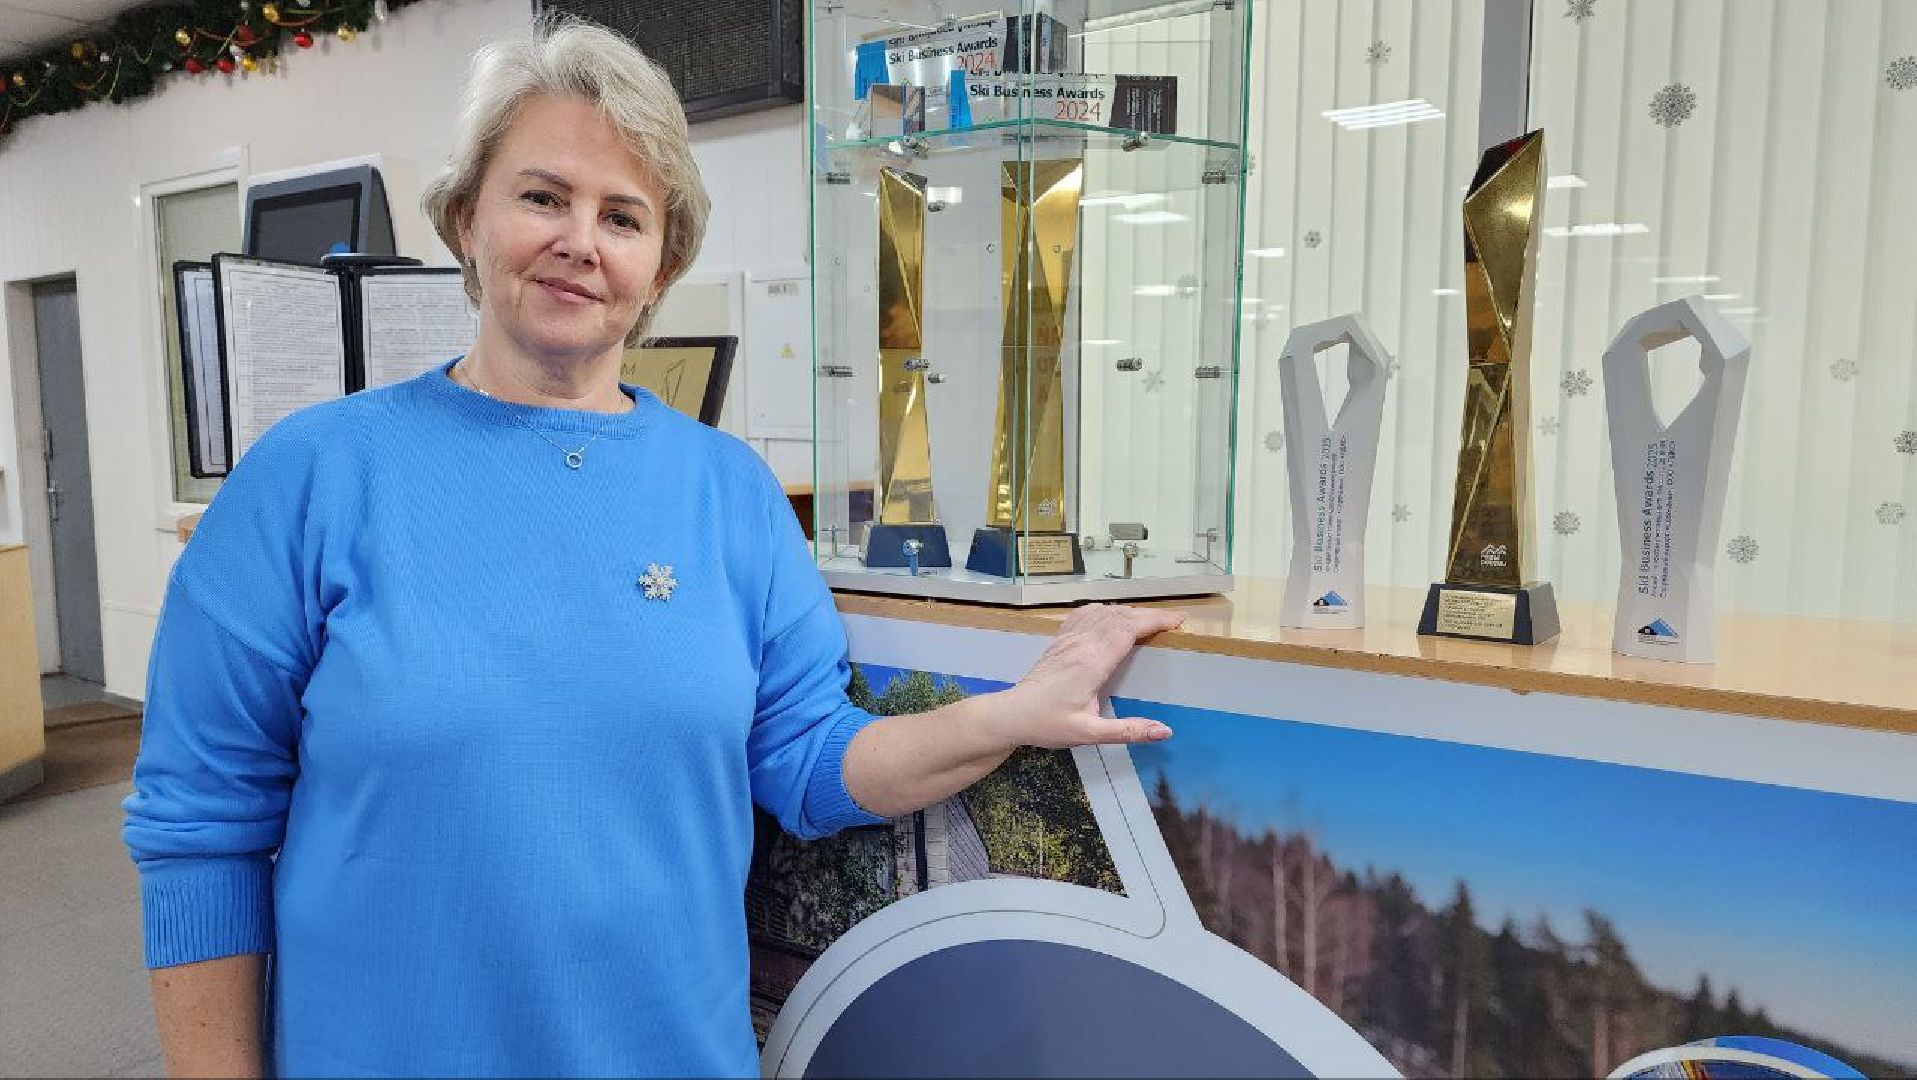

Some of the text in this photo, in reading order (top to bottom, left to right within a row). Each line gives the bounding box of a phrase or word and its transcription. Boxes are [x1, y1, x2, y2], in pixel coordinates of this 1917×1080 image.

[889, 37, 998, 64] Ski Business Awards
[970, 84, 1105, 100] Ski Busness Awards
[1055, 100, 1101, 121] 2024
[1317, 463, 1327, 504] Awards
[1642, 470, 1654, 516] Awards
[1641, 519, 1652, 572] Business
[1639, 576, 1649, 595] Ski
